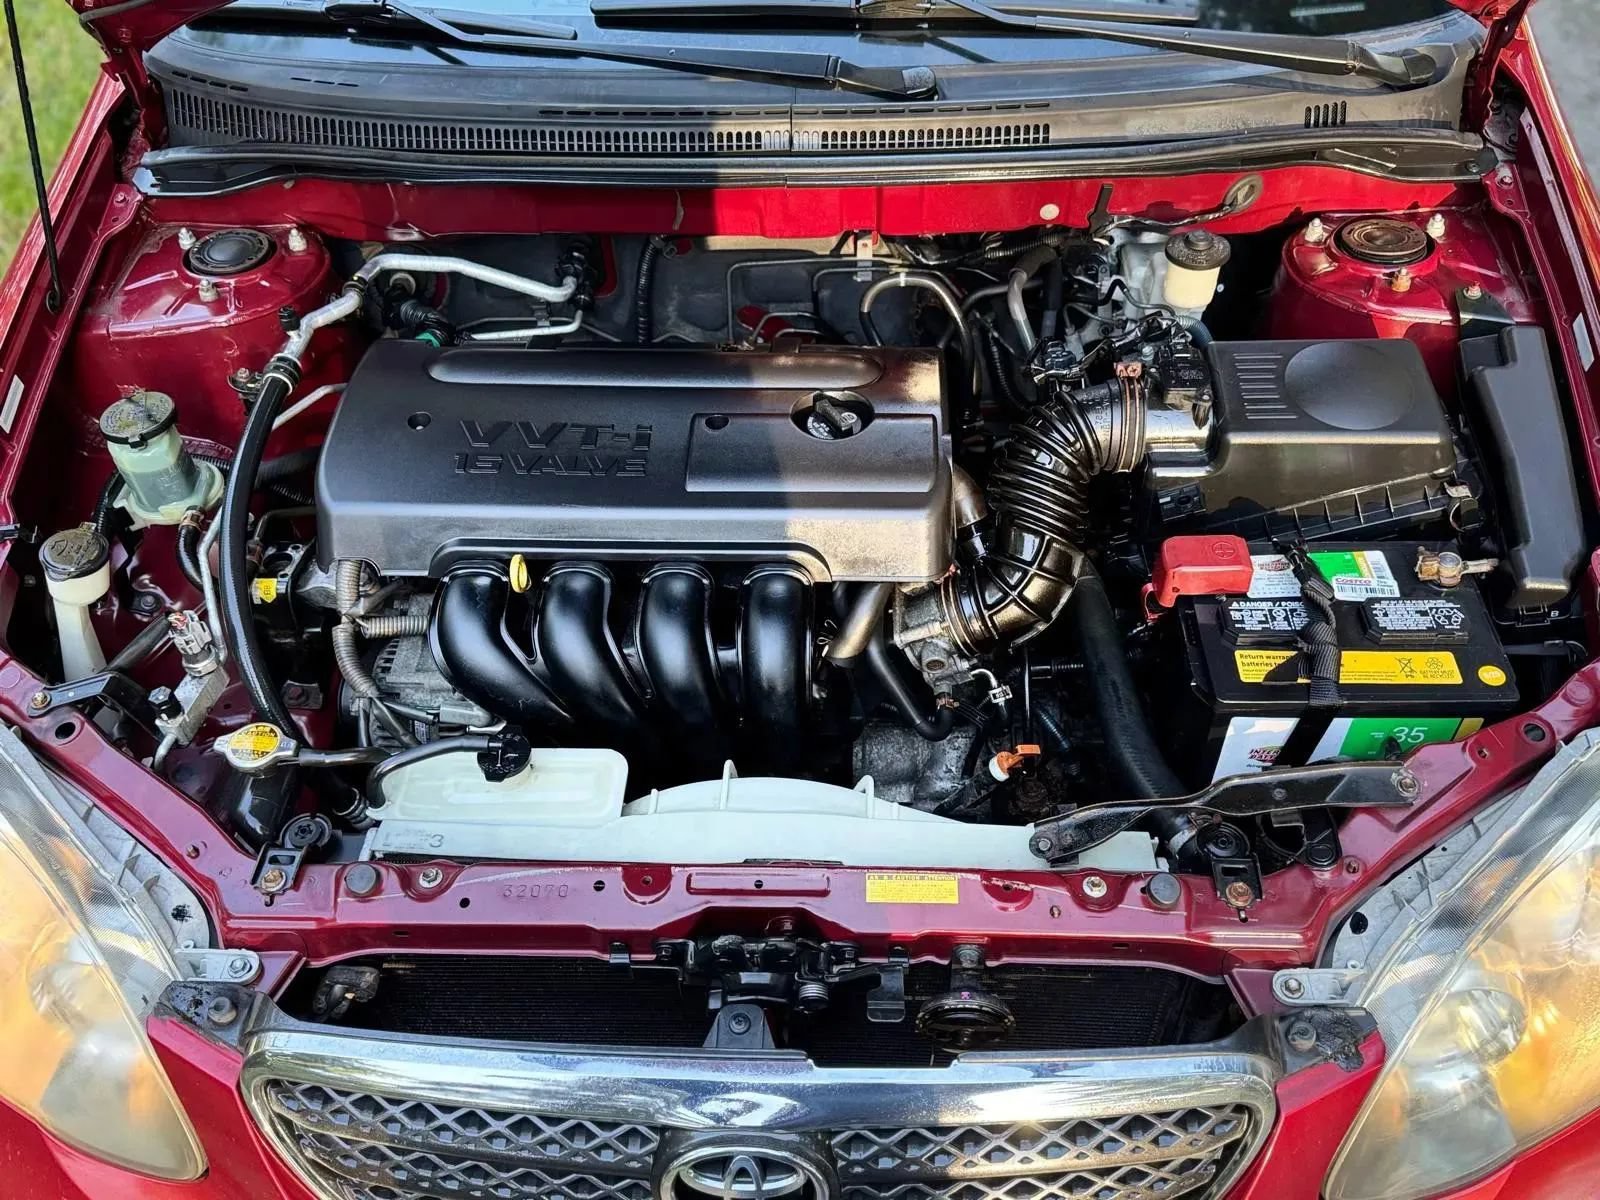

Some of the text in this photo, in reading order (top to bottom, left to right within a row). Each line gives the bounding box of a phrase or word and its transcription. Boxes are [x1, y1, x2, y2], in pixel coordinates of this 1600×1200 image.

[454, 453, 647, 477] 16 VALVE
[1335, 577, 1372, 585] COSTCO
[1392, 726, 1429, 743] 35
[503, 884, 570, 899] 32070
